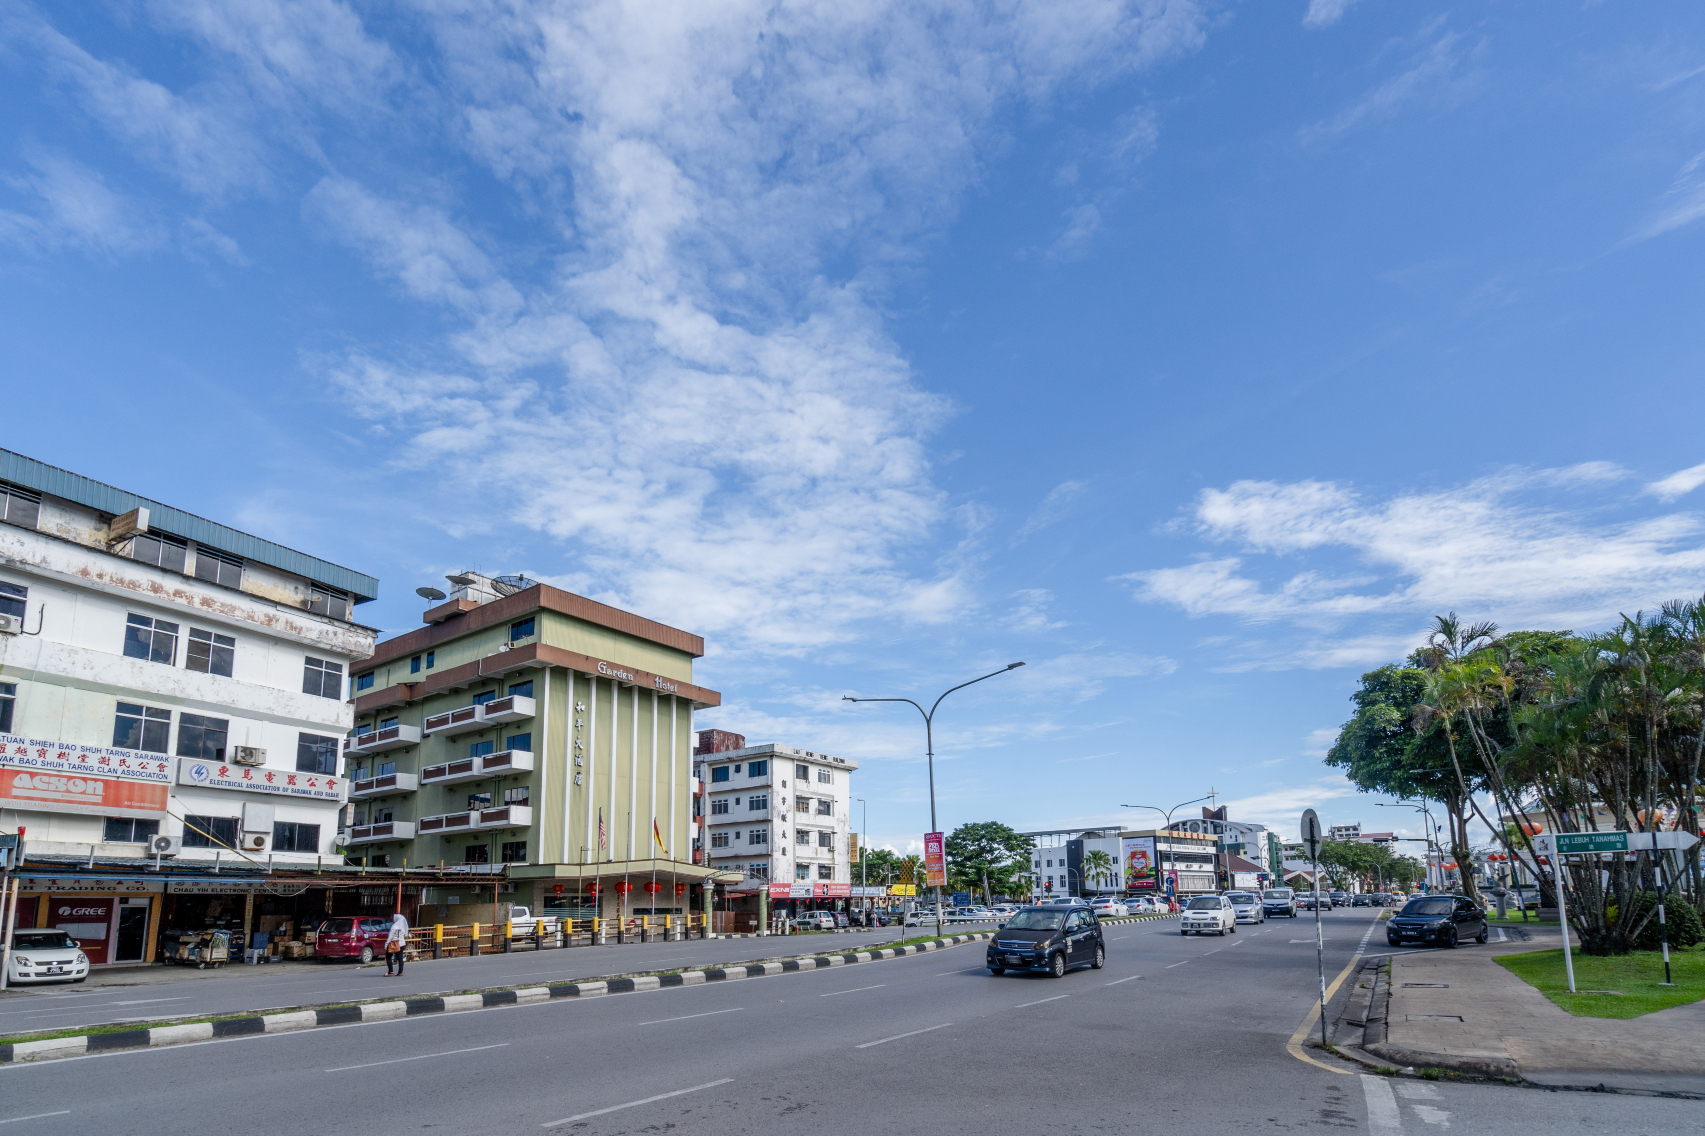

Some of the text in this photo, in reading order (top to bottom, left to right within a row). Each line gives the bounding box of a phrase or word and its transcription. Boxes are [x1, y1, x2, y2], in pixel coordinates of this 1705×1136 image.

[598, 661, 677, 692] Garden Hotel
[0, 735, 170, 763] TUAN SHIEH BAO SHUH TARNG SARAWAK
[18, 757, 38, 766] BAO
[40, 760, 65, 769] SHUH
[67, 762, 95, 772] TARNG
[97, 766, 118, 775] CLAN
[120, 769, 169, 780] ASSOCIATION
[217, 765, 338, 791] 東馬電器公會
[209, 778, 244, 788] ELECTRICAL
[245, 782, 281, 792] ASSOCIATION
[291, 788, 313, 796] SARAWAK
[23, 801, 55, 810] TRADING
[56, 804, 89, 812] COMPANY
[1592, 834, 1624, 842] TANAHMAS
[72, 907, 107, 916] GREE
